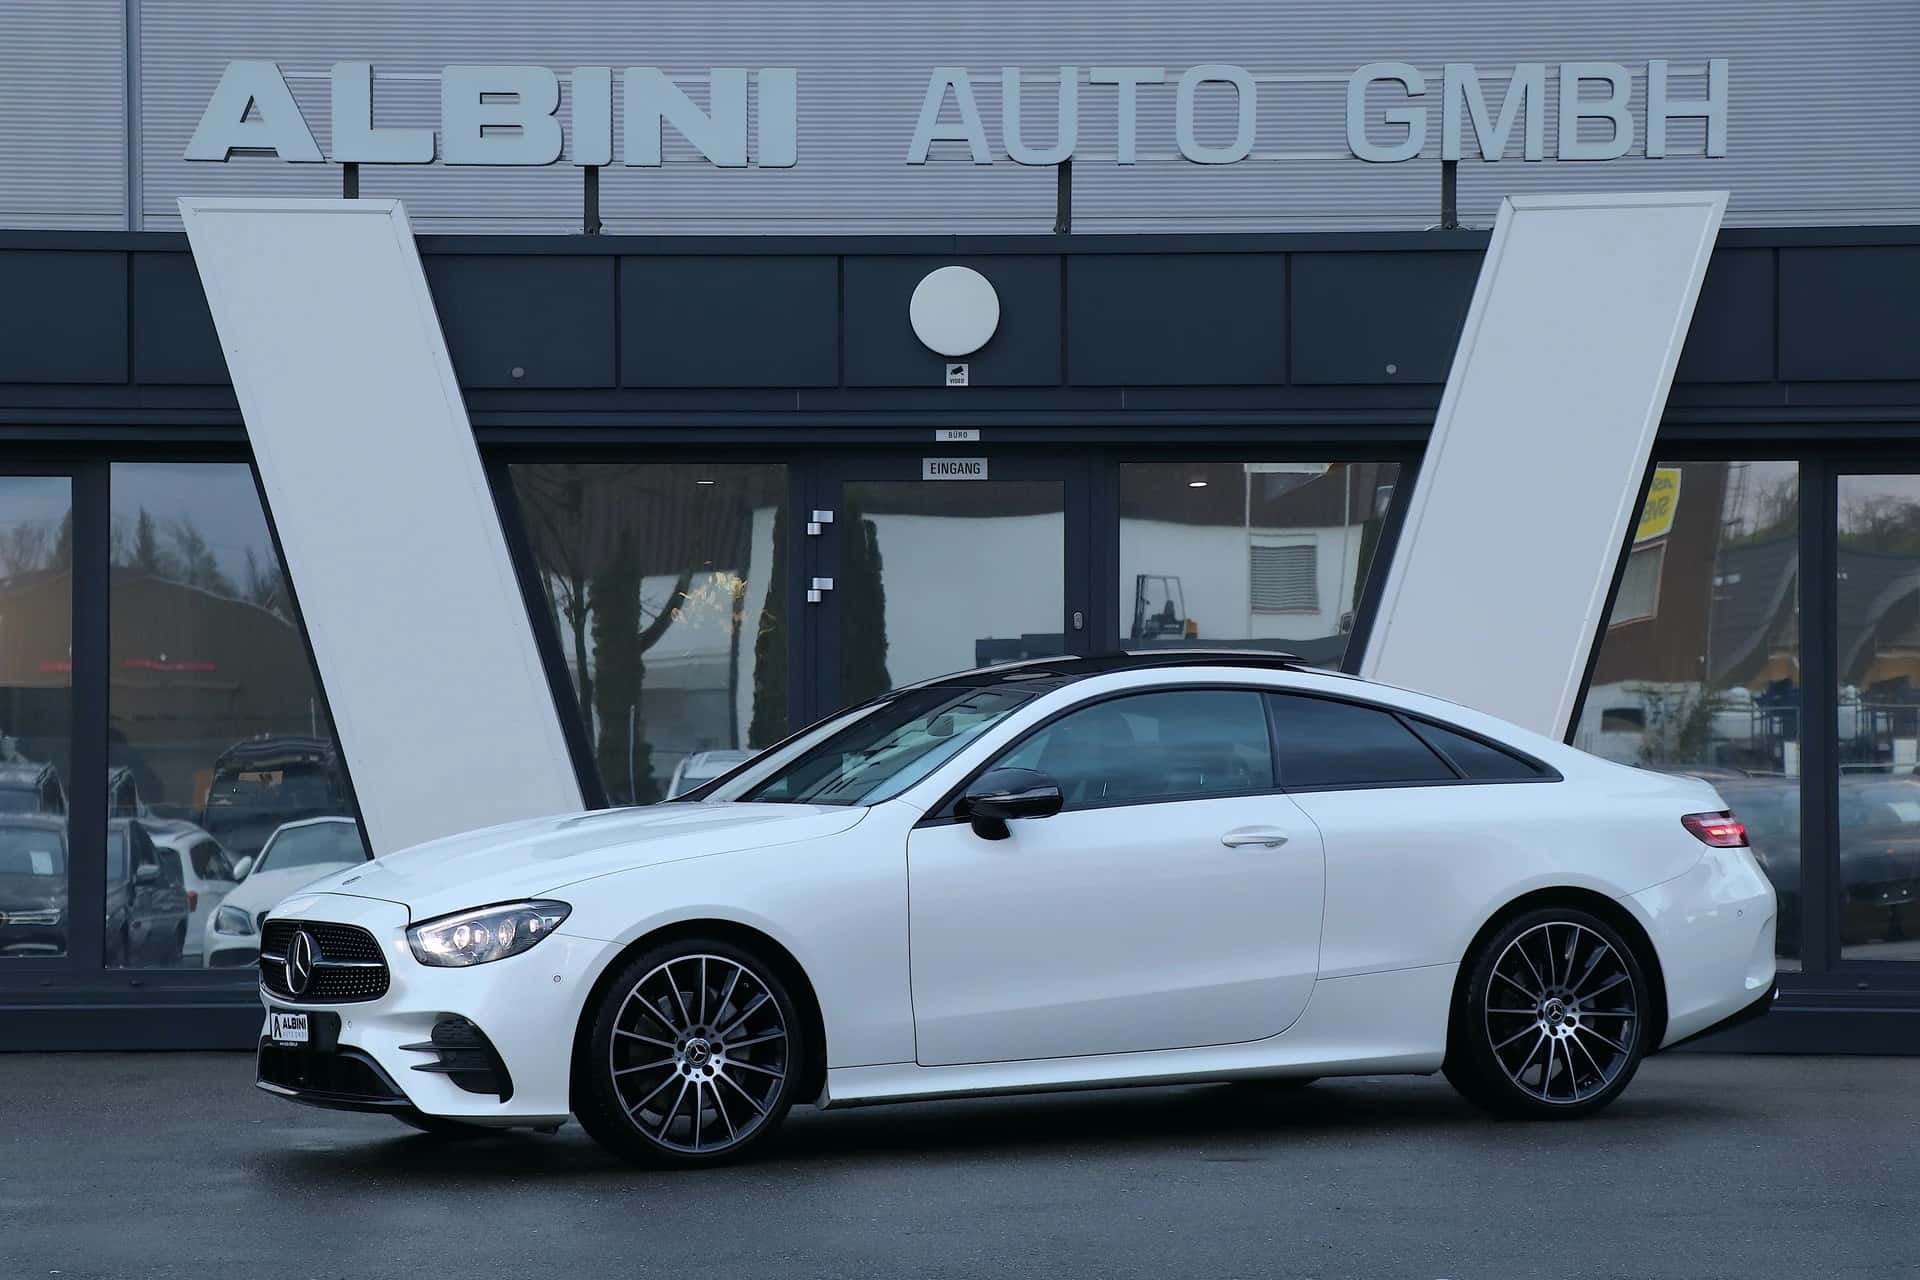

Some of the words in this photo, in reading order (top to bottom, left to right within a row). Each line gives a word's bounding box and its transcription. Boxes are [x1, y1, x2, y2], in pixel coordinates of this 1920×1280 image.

[184, 60, 798, 168] ALBINI
[906, 63, 1259, 166] AUTO
[1346, 58, 1730, 164] GMBH
[948, 431, 968, 439] BÜRO
[930, 462, 981, 475] EINGANG
[283, 1017, 306, 1030] ALBINI
